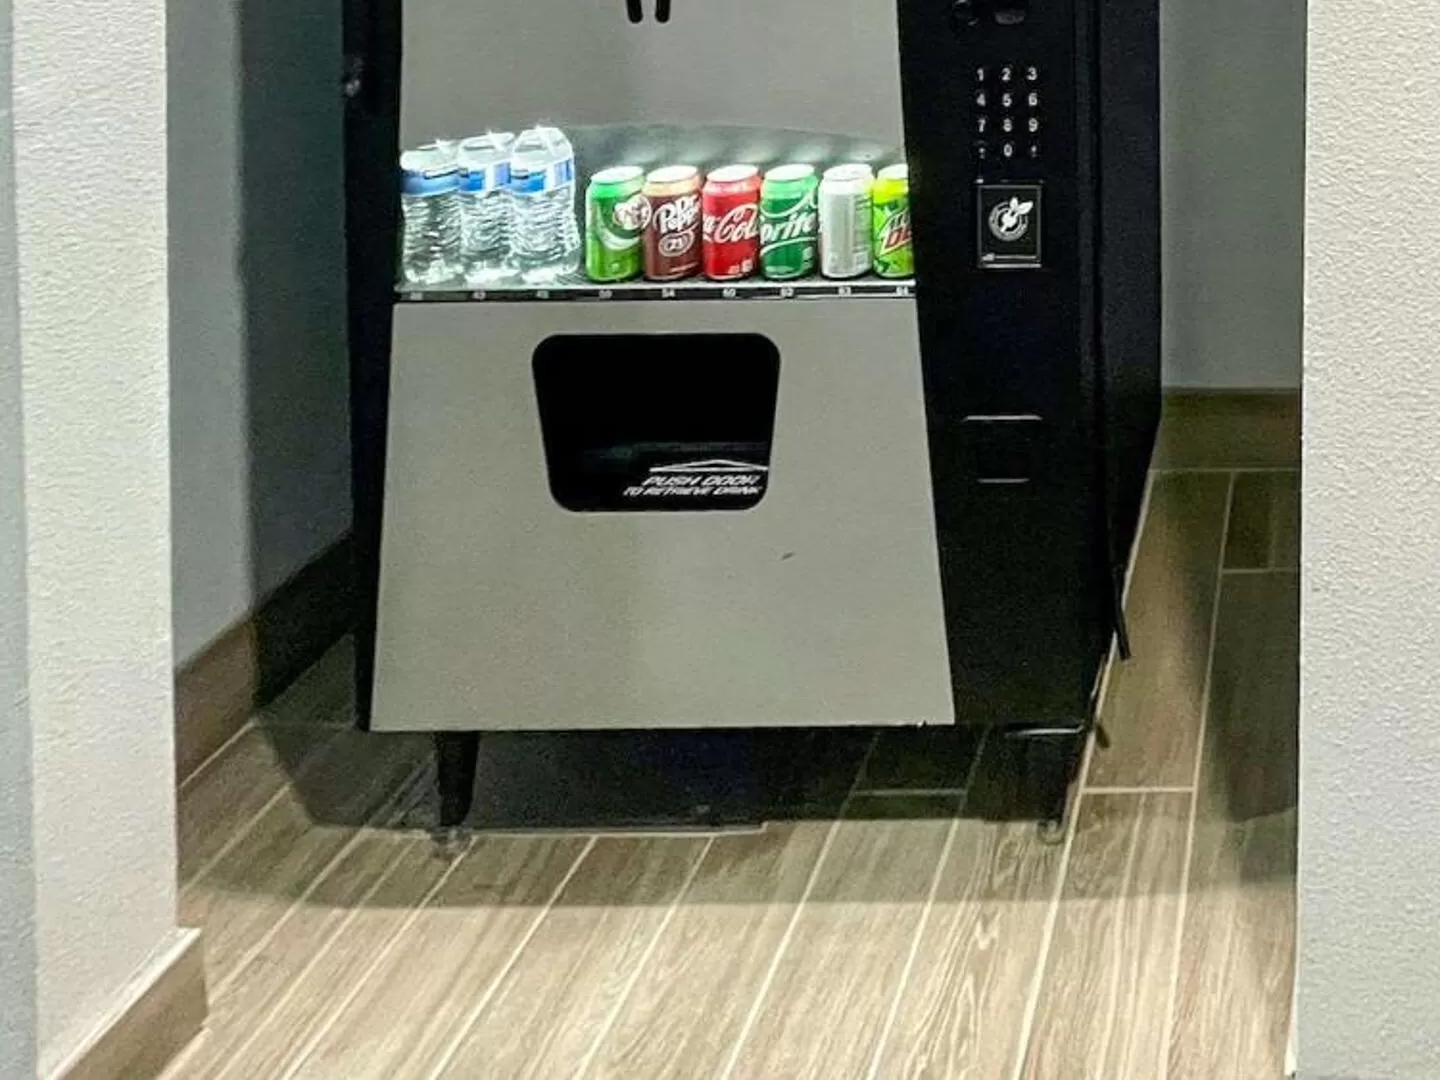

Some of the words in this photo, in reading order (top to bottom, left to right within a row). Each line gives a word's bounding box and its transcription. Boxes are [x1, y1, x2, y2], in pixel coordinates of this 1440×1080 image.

[976, 67, 984, 81] 1
[1001, 67, 1011, 81] 2
[1027, 66, 1038, 81] 3
[976, 93, 986, 107] 4
[1002, 93, 1012, 107] 5
[1028, 92, 1038, 107] 6
[977, 118, 986, 133] 7
[1003, 118, 1012, 132] 8
[1028, 118, 1038, 132] 9
[1003, 144, 1013, 157] 0
